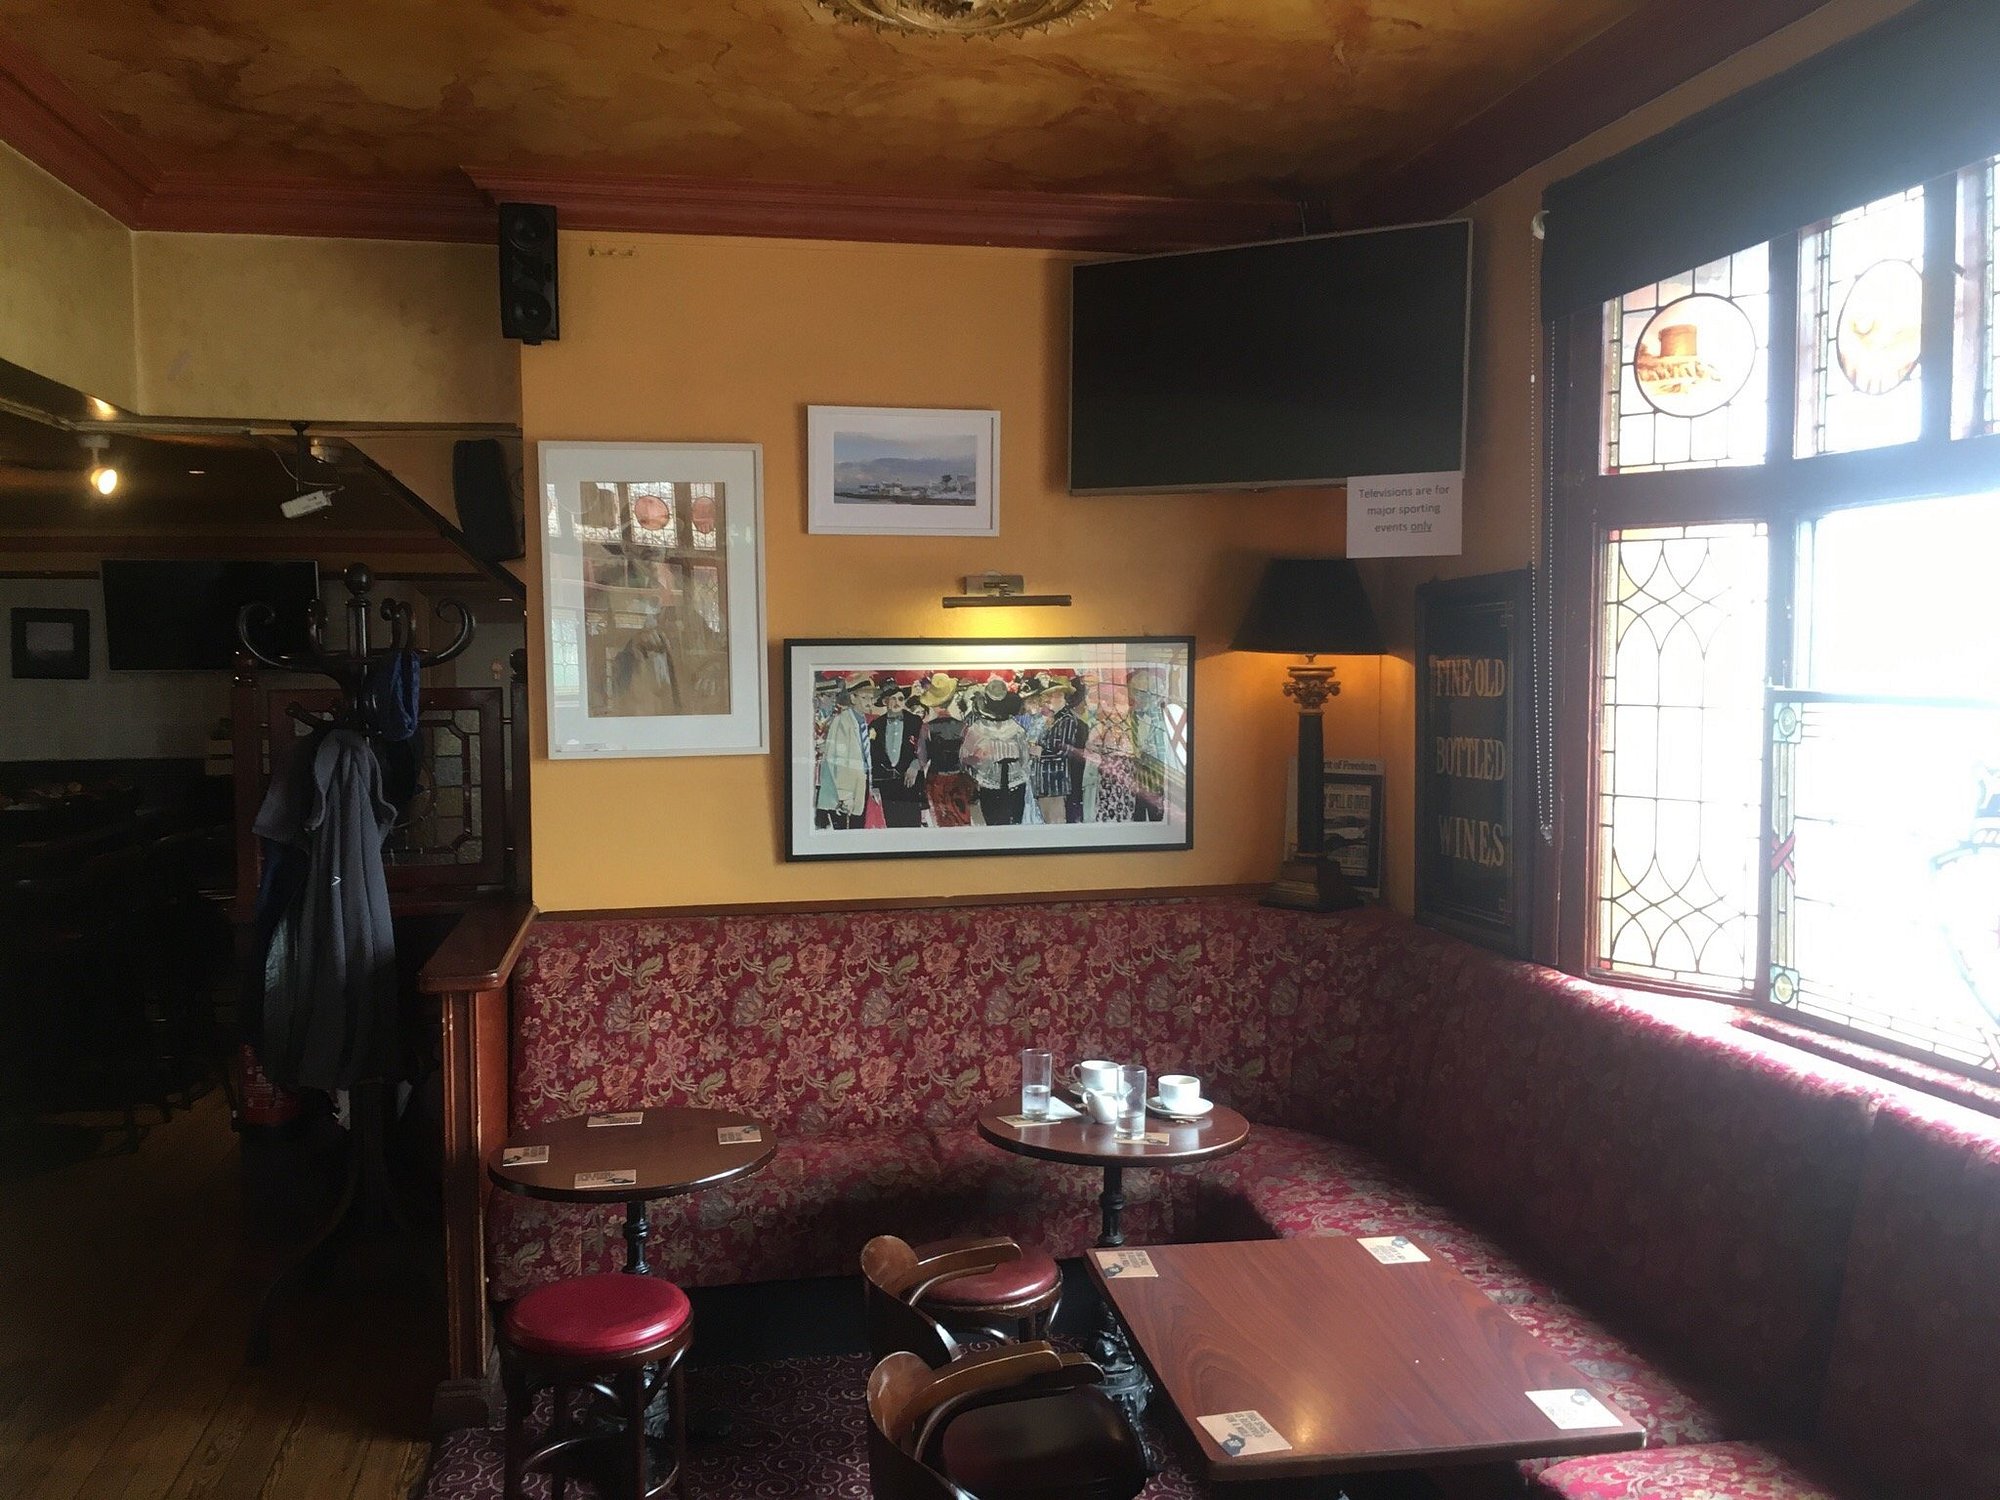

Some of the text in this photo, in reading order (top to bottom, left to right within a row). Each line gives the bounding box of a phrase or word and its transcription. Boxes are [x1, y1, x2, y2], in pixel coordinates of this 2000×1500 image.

[1358, 485, 1450, 499] Televisions are for
[1367, 503, 1441, 517] major sporting
[1374, 520, 1432, 533] events only
[1435, 658, 1505, 698] FINE OLD
[1435, 736, 1506, 781] BOTTLED
[1438, 814, 1505, 867] WINES
